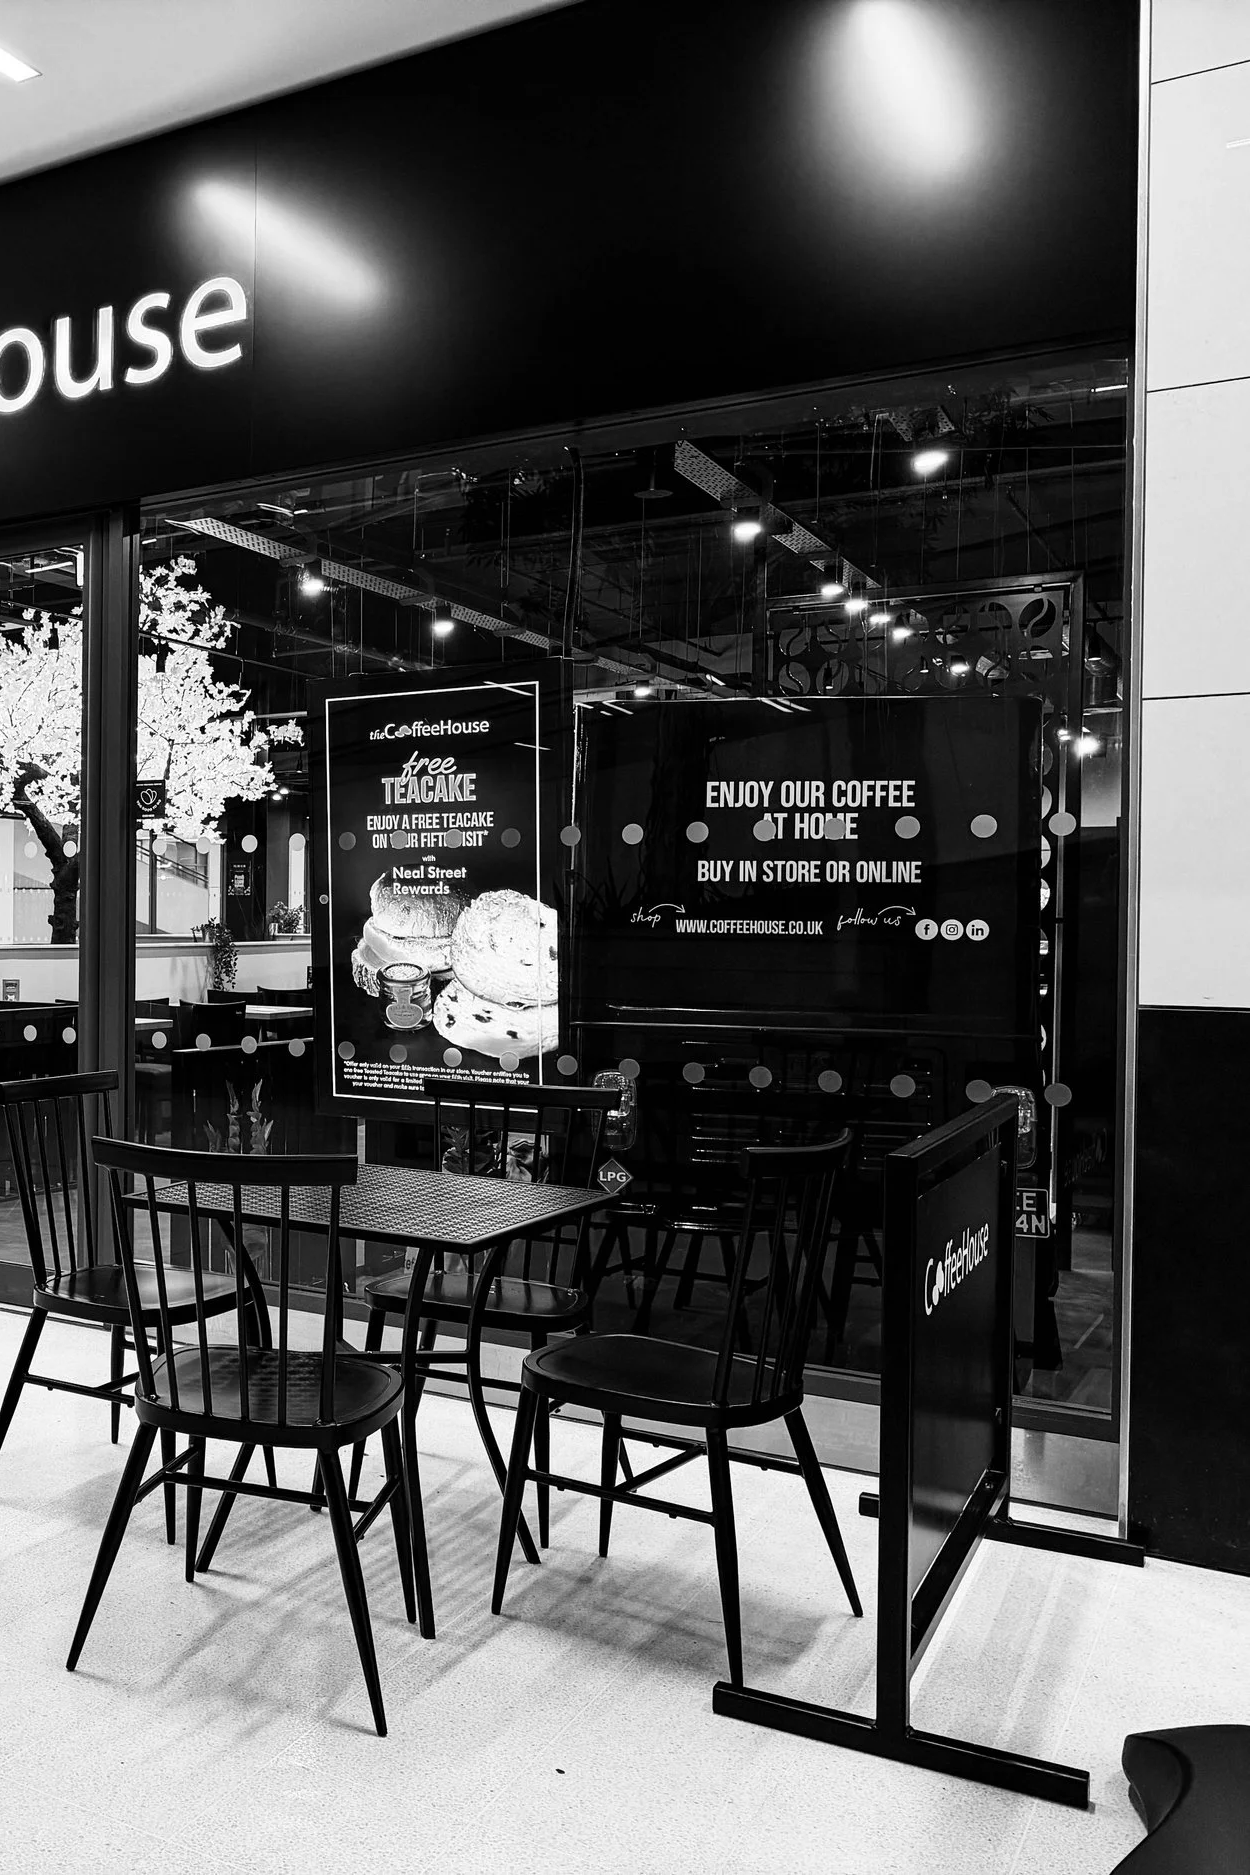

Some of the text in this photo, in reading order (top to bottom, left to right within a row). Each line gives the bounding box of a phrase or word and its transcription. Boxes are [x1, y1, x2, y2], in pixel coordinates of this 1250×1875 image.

[401, 750, 457, 785] free
[381, 773, 477, 804] TEACAKE
[706, 780, 915, 807] ENJOY OUR COFFEE
[367, 811, 494, 830] ENJOY A FREE TEACAKE
[372, 834, 387, 848] ON
[456, 830, 489, 848] ISIT
[392, 865, 467, 879] Neal Street
[697, 860, 922, 883] BUY IN STORE OR ONLINE
[393, 881, 450, 895] Rewards
[630, 906, 662, 928] shop
[837, 908, 902, 931] follow us
[676, 919, 824, 936] WWW.COFFEEHOUSE.CO.UK
[599, 1171, 627, 1183] LPG
